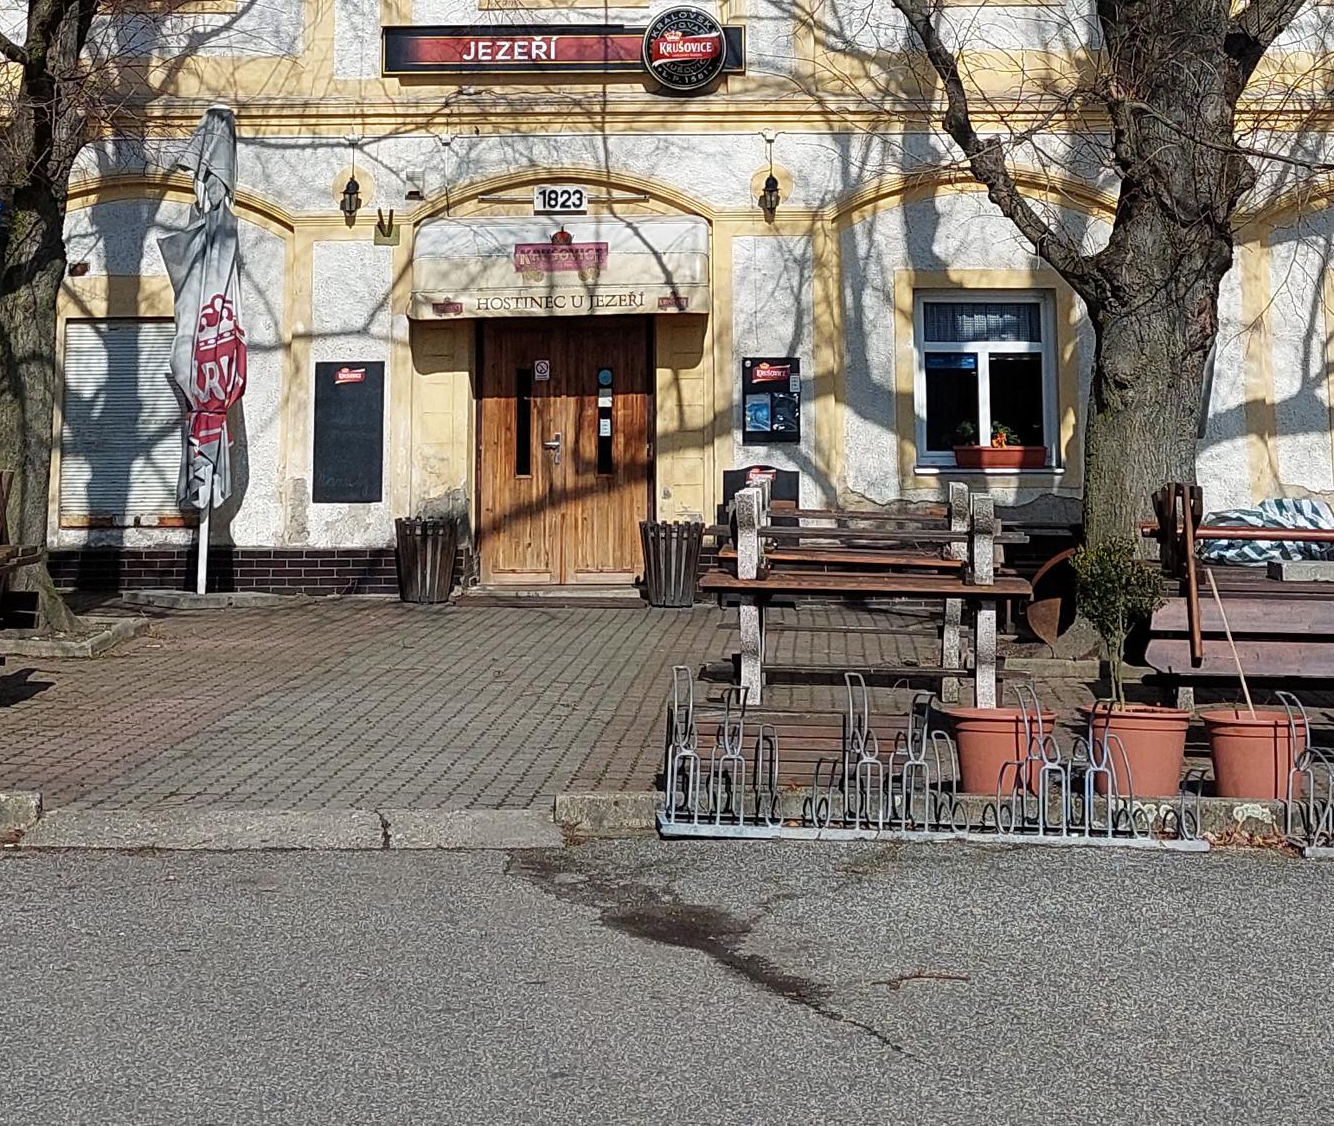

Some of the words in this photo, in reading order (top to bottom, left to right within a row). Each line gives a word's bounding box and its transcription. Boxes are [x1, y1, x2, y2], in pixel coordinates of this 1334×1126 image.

[462, 36, 558, 61] JEZEŘÍ
[659, 40, 713, 56] KRUŠOVICE
[538, 189, 584, 209] 1823
[476, 295, 566, 311] HOSTINEC
[572, 295, 585, 308] U
[587, 291, 646, 312] JEZEŘÍ
